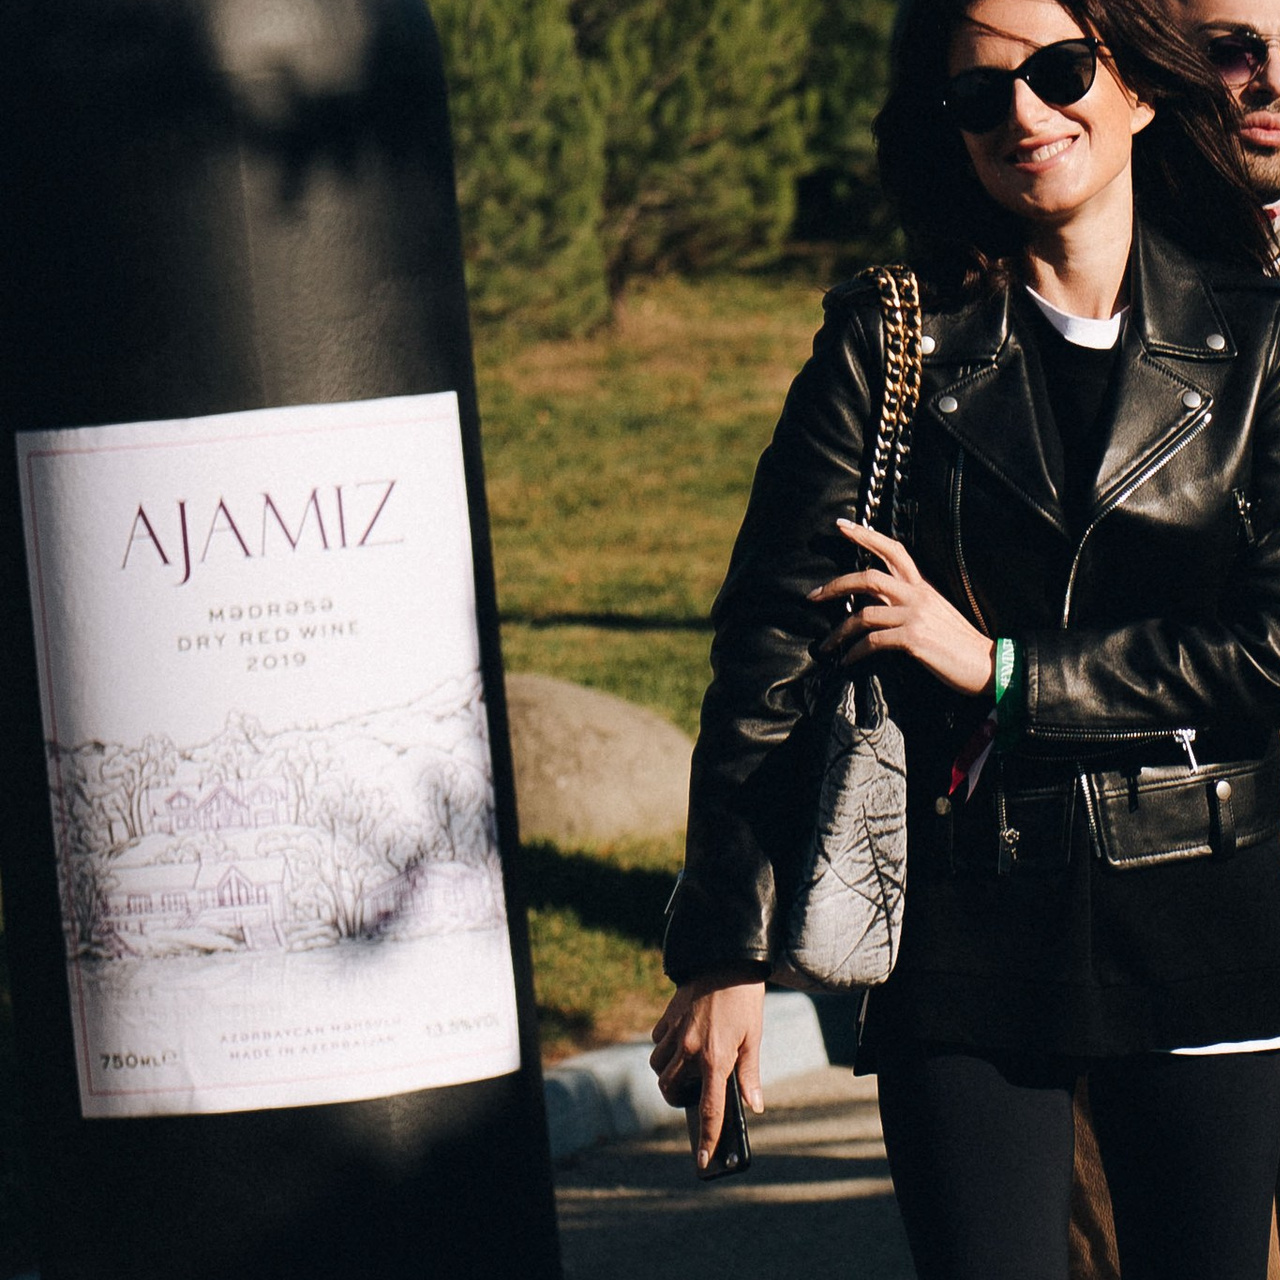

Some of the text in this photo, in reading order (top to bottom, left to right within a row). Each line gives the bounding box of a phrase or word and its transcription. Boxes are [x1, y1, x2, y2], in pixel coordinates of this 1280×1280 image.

[121, 479, 404, 586] AJAMIZ
[177, 619, 359, 652] DRY RED WINE
[246, 651, 307, 672] 2019
[229, 1048, 271, 1060] MADE
